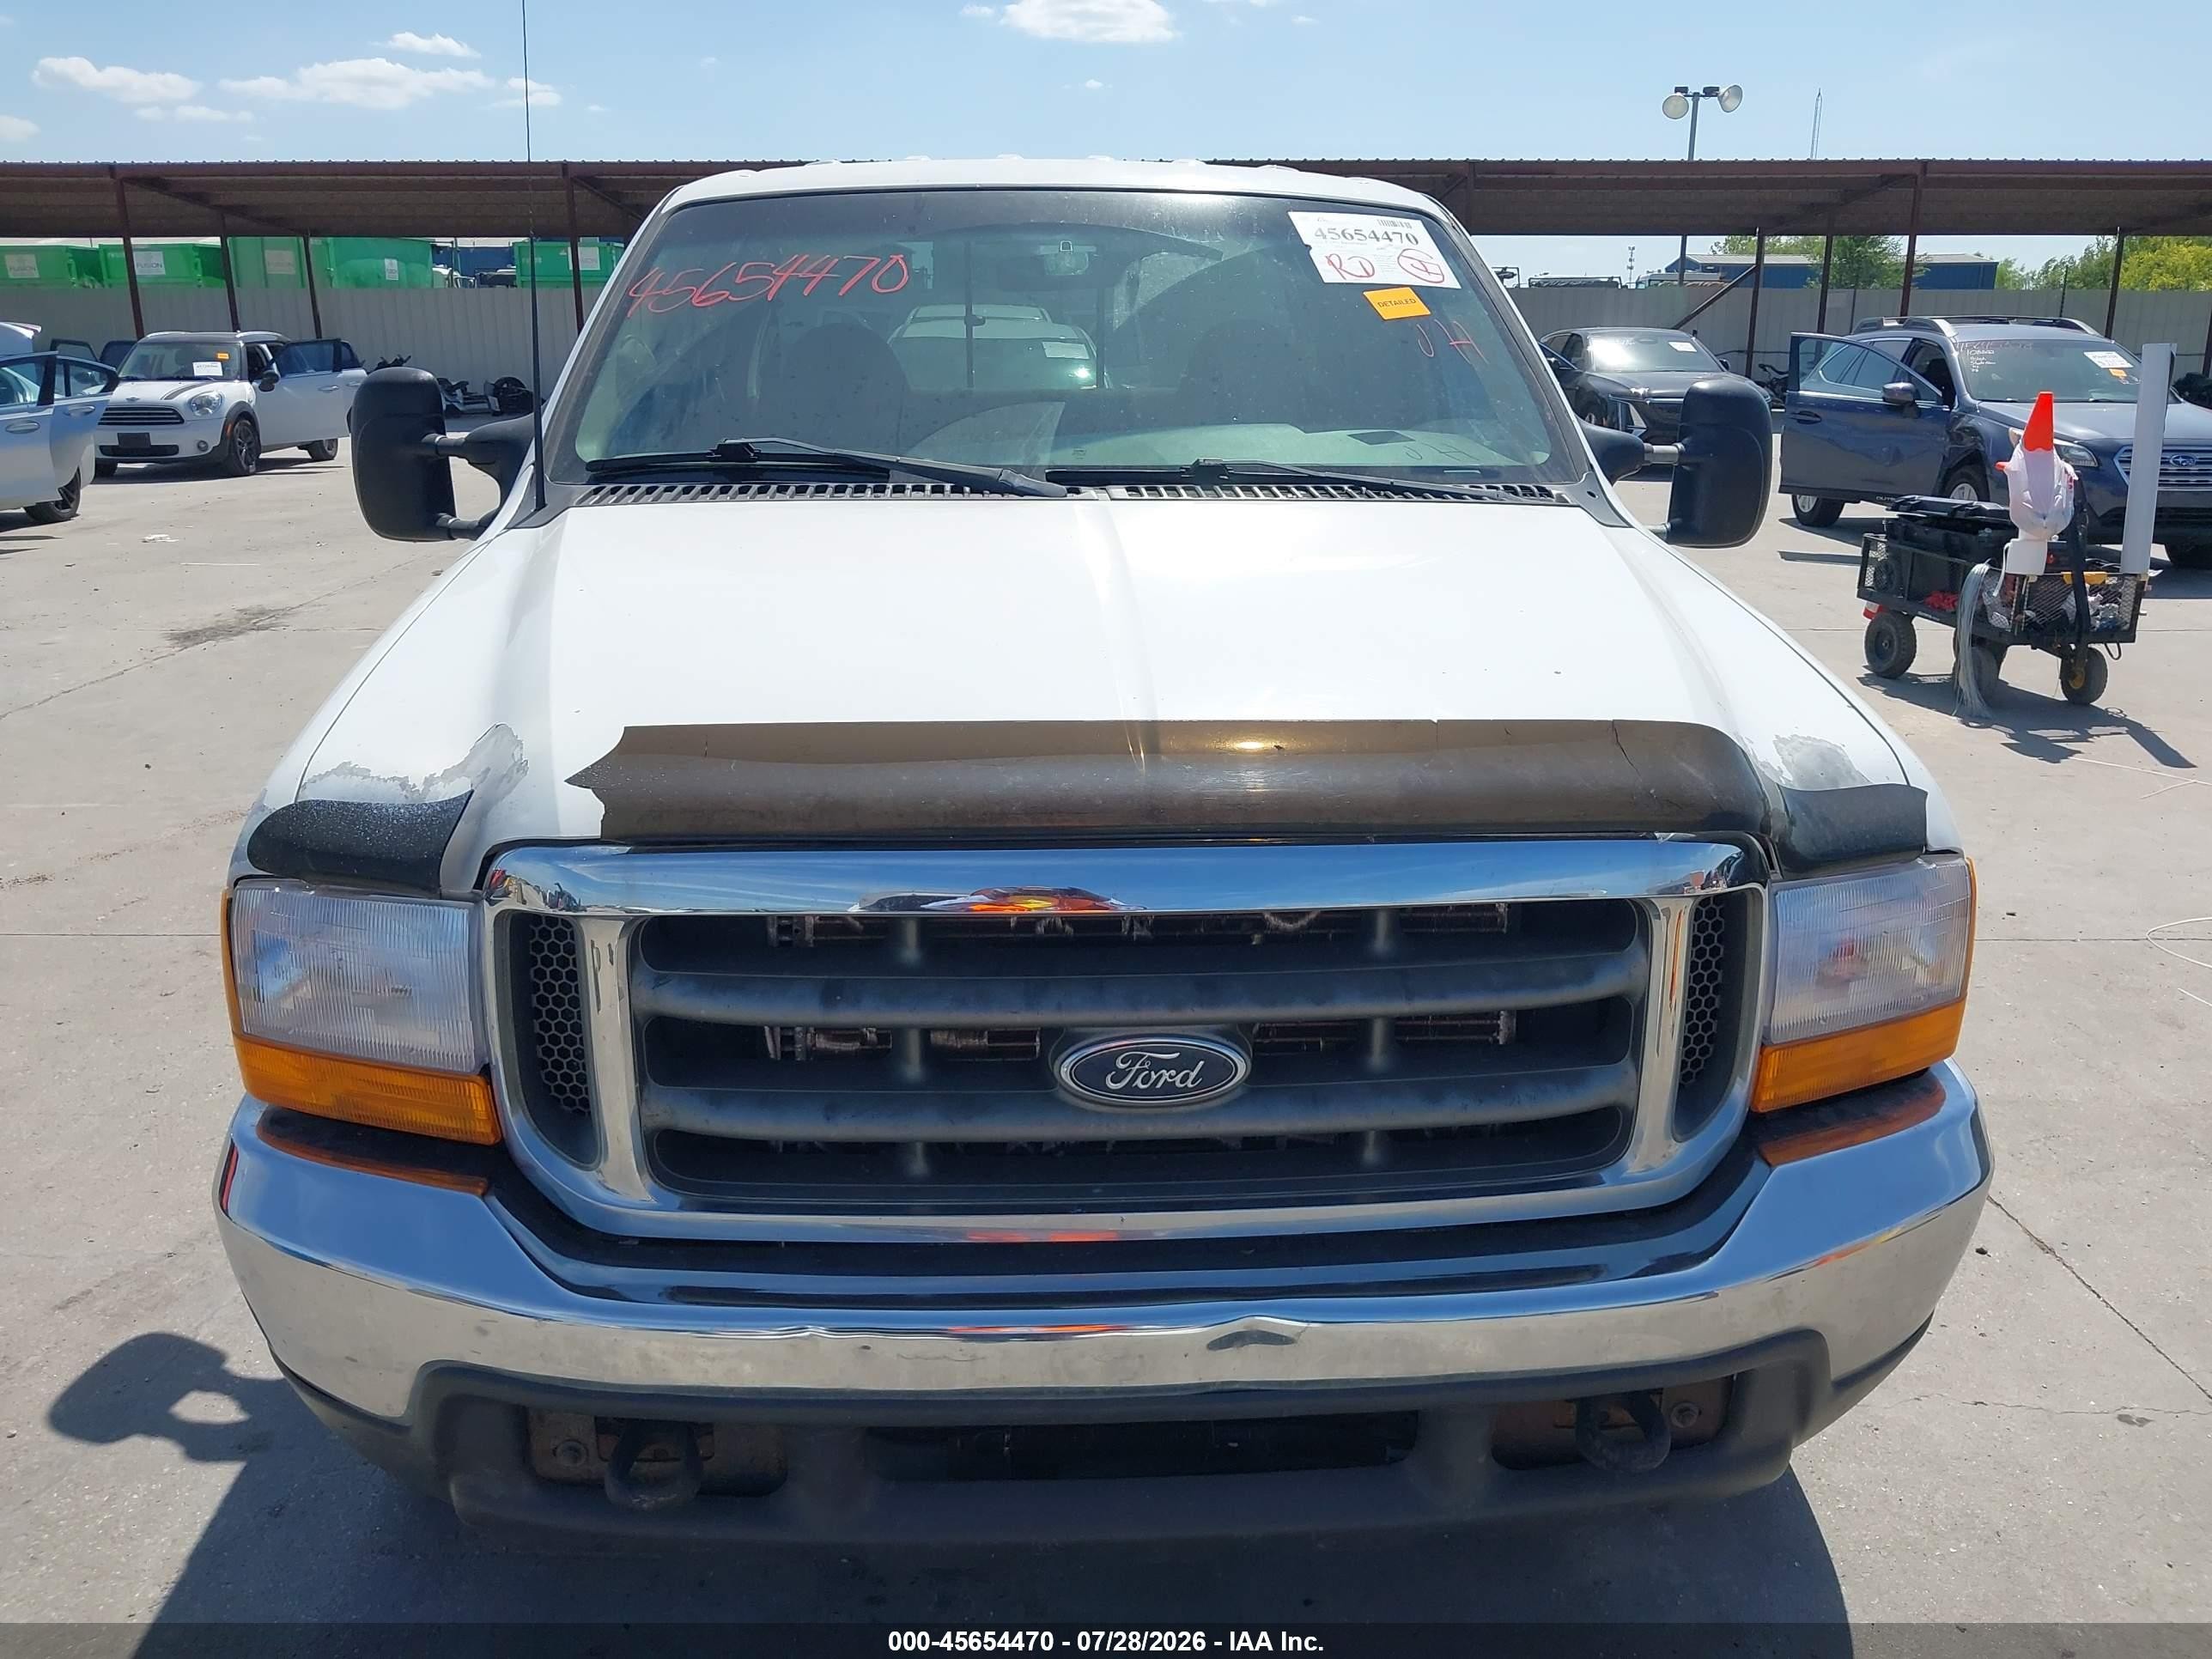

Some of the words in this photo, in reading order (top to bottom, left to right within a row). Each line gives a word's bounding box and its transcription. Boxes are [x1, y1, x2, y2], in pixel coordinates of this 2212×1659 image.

[1315, 227, 1419, 246] 45654470
[627, 254, 909, 318] 45654470
[1377, 298, 1416, 308] DETAILED
[1105, 1051, 1205, 1090] Ford
